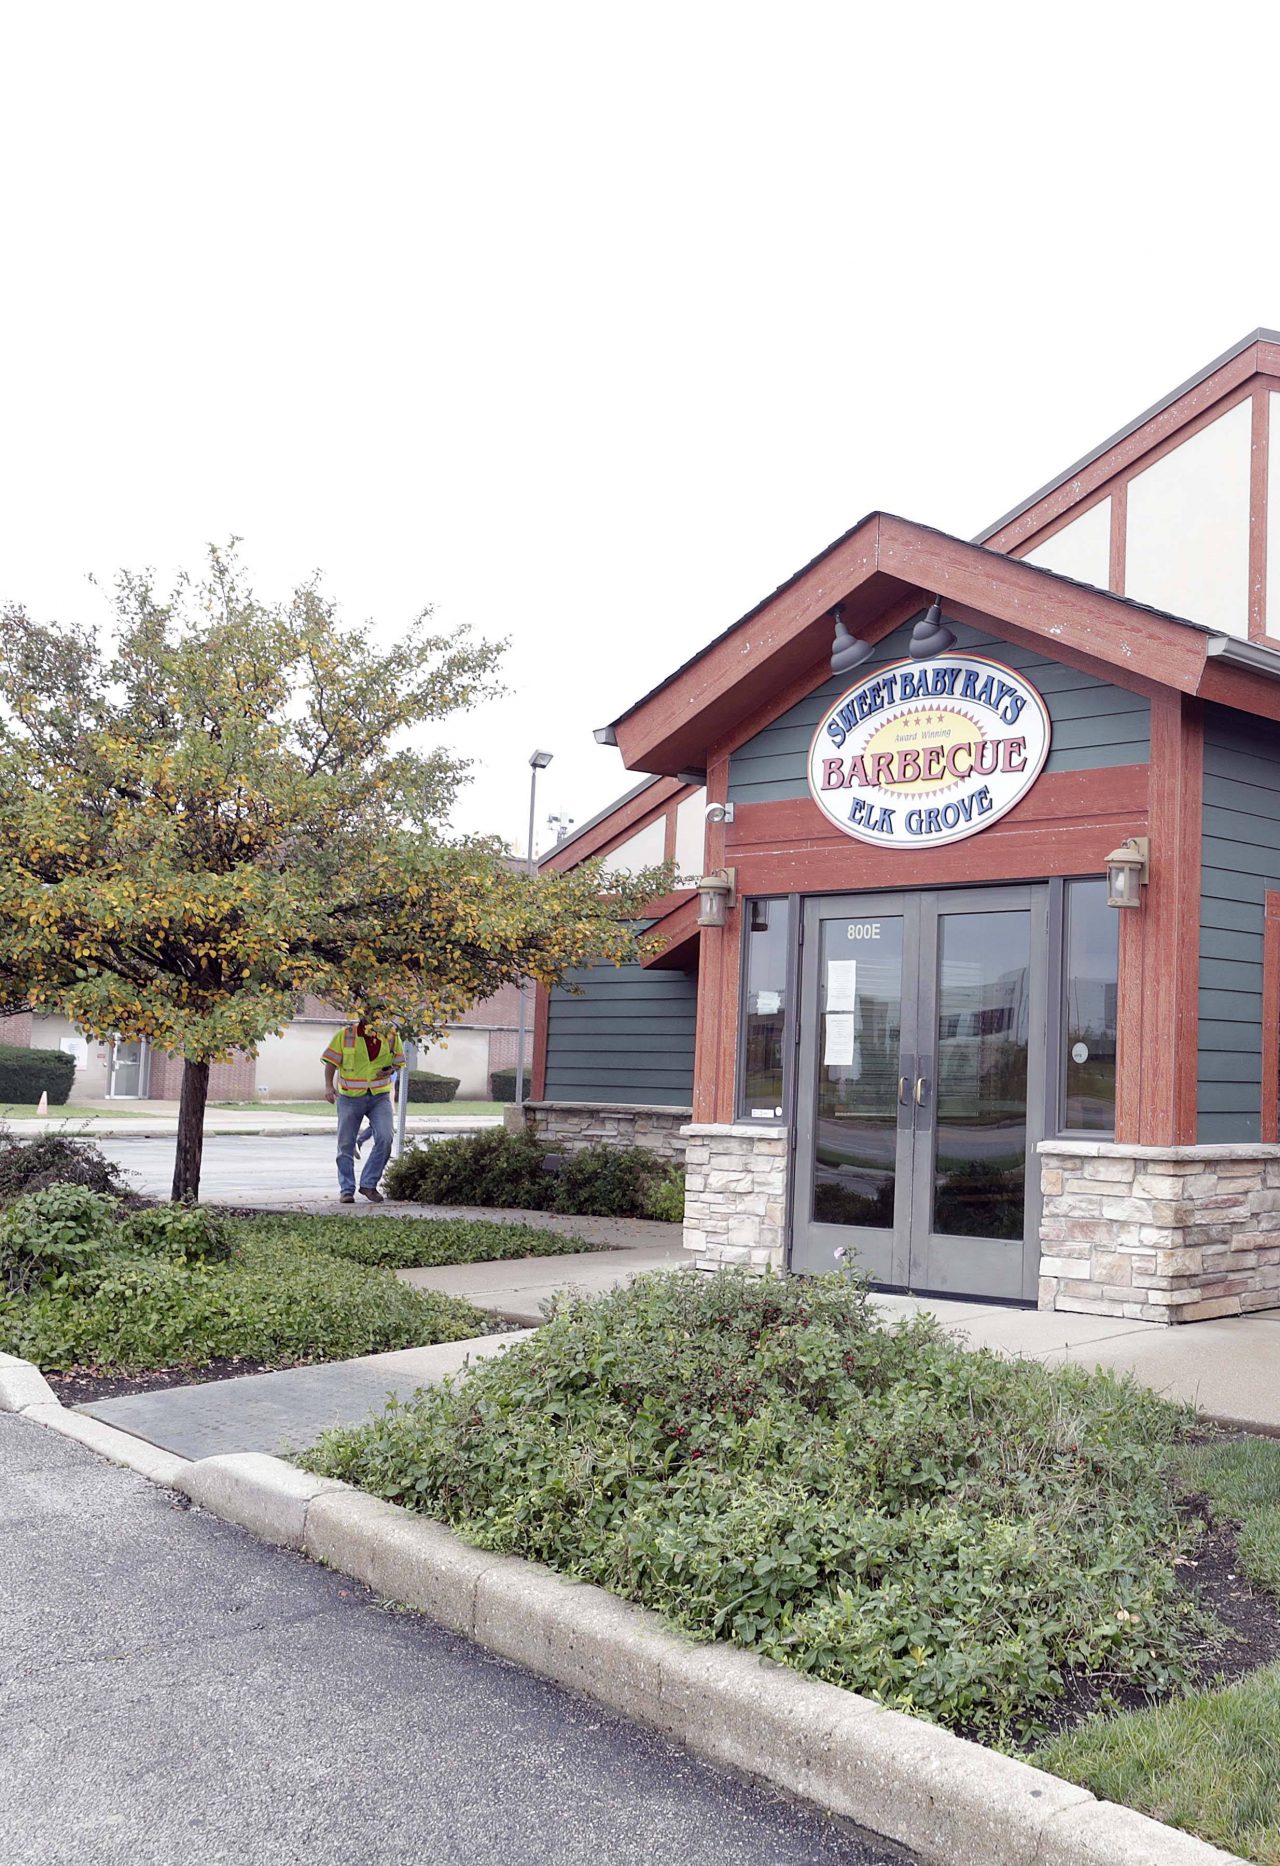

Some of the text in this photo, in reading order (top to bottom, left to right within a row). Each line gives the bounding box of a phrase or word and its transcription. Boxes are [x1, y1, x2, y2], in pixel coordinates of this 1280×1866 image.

[827, 667, 1027, 749] SWEET BABY RAY'S
[895, 728, 951, 743] Award Winning
[821, 736, 1027, 790] BARBECUE
[848, 785, 993, 835] ELK GROVE
[847, 923, 881, 939] 800E
